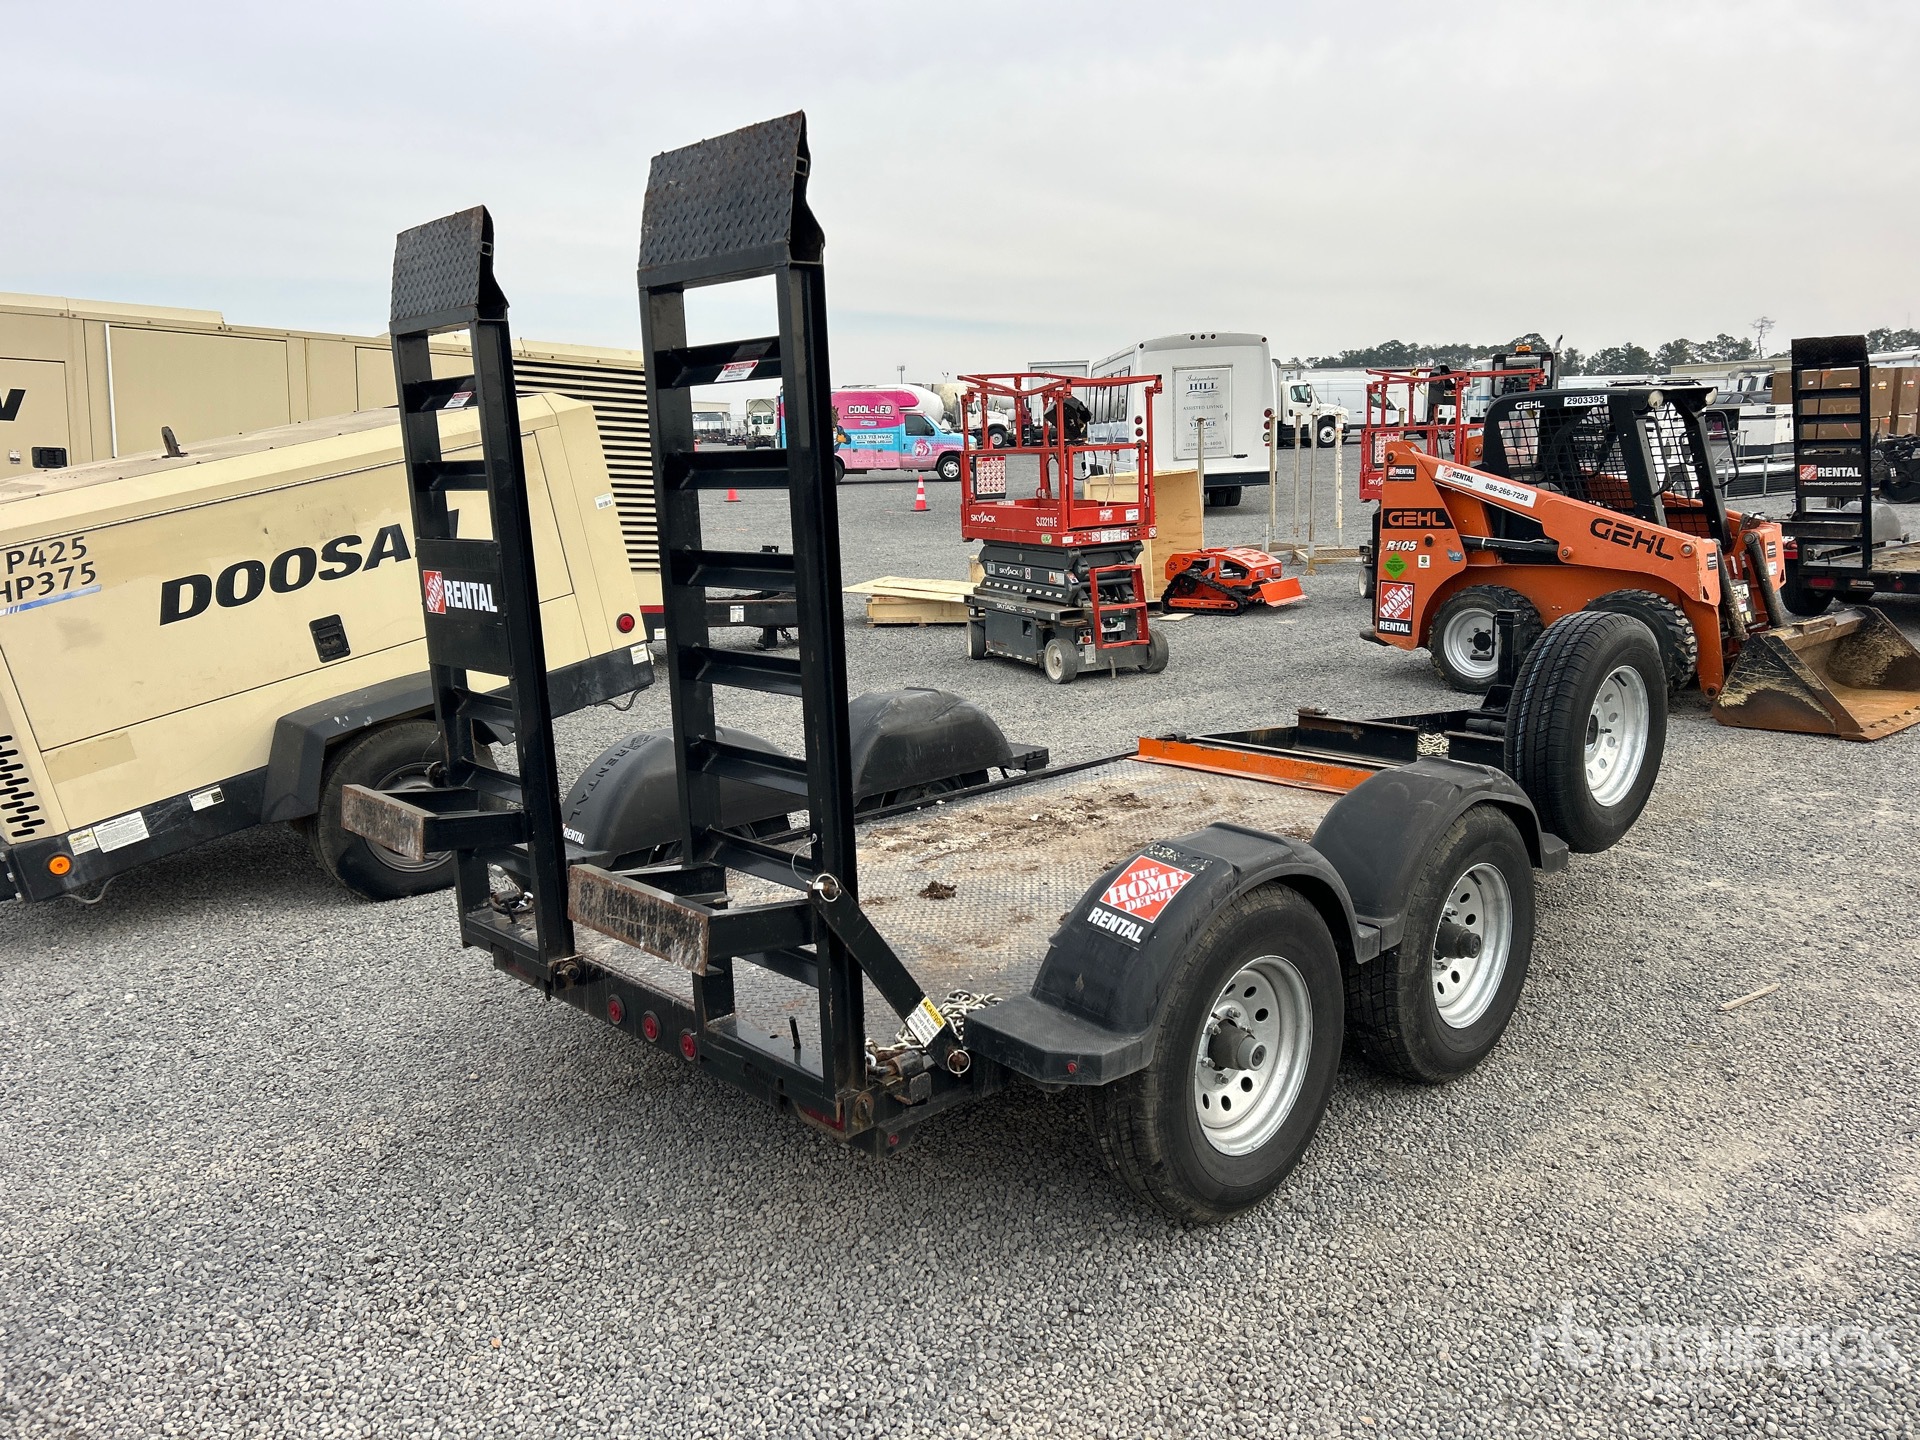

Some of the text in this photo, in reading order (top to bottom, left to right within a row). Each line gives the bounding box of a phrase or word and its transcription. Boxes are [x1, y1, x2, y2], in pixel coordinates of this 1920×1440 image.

[1515, 400, 1545, 410] GEHL
[1567, 396, 1605, 404] 2903395
[848, 405, 891, 414] COOL-LEO
[1452, 471, 1474, 484] RENTAL
[1818, 467, 1862, 477] RENTAL
[970, 511, 996, 523] SKYJACK
[1388, 511, 1446, 526] GEHL
[1386, 540, 1418, 552] R105
[1590, 518, 1674, 561] GEHL
[6, 536, 87, 574] P425
[160, 523, 411, 626] DOOSA
[443, 580, 498, 612] RENTAL
[1384, 586, 1398, 600] THE
[996, 602, 1017, 612] SKYJACK
[1380, 584, 1413, 618] HOME
[1392, 598, 1412, 618] DEPOT
[1379, 621, 1410, 633] RENTAL
[564, 827, 585, 845] RENTAL
[1129, 867, 1160, 881] THE
[1108, 870, 1186, 905] HOME
[1124, 888, 1174, 912] DEPOT
[1087, 907, 1144, 943] RENTAL
